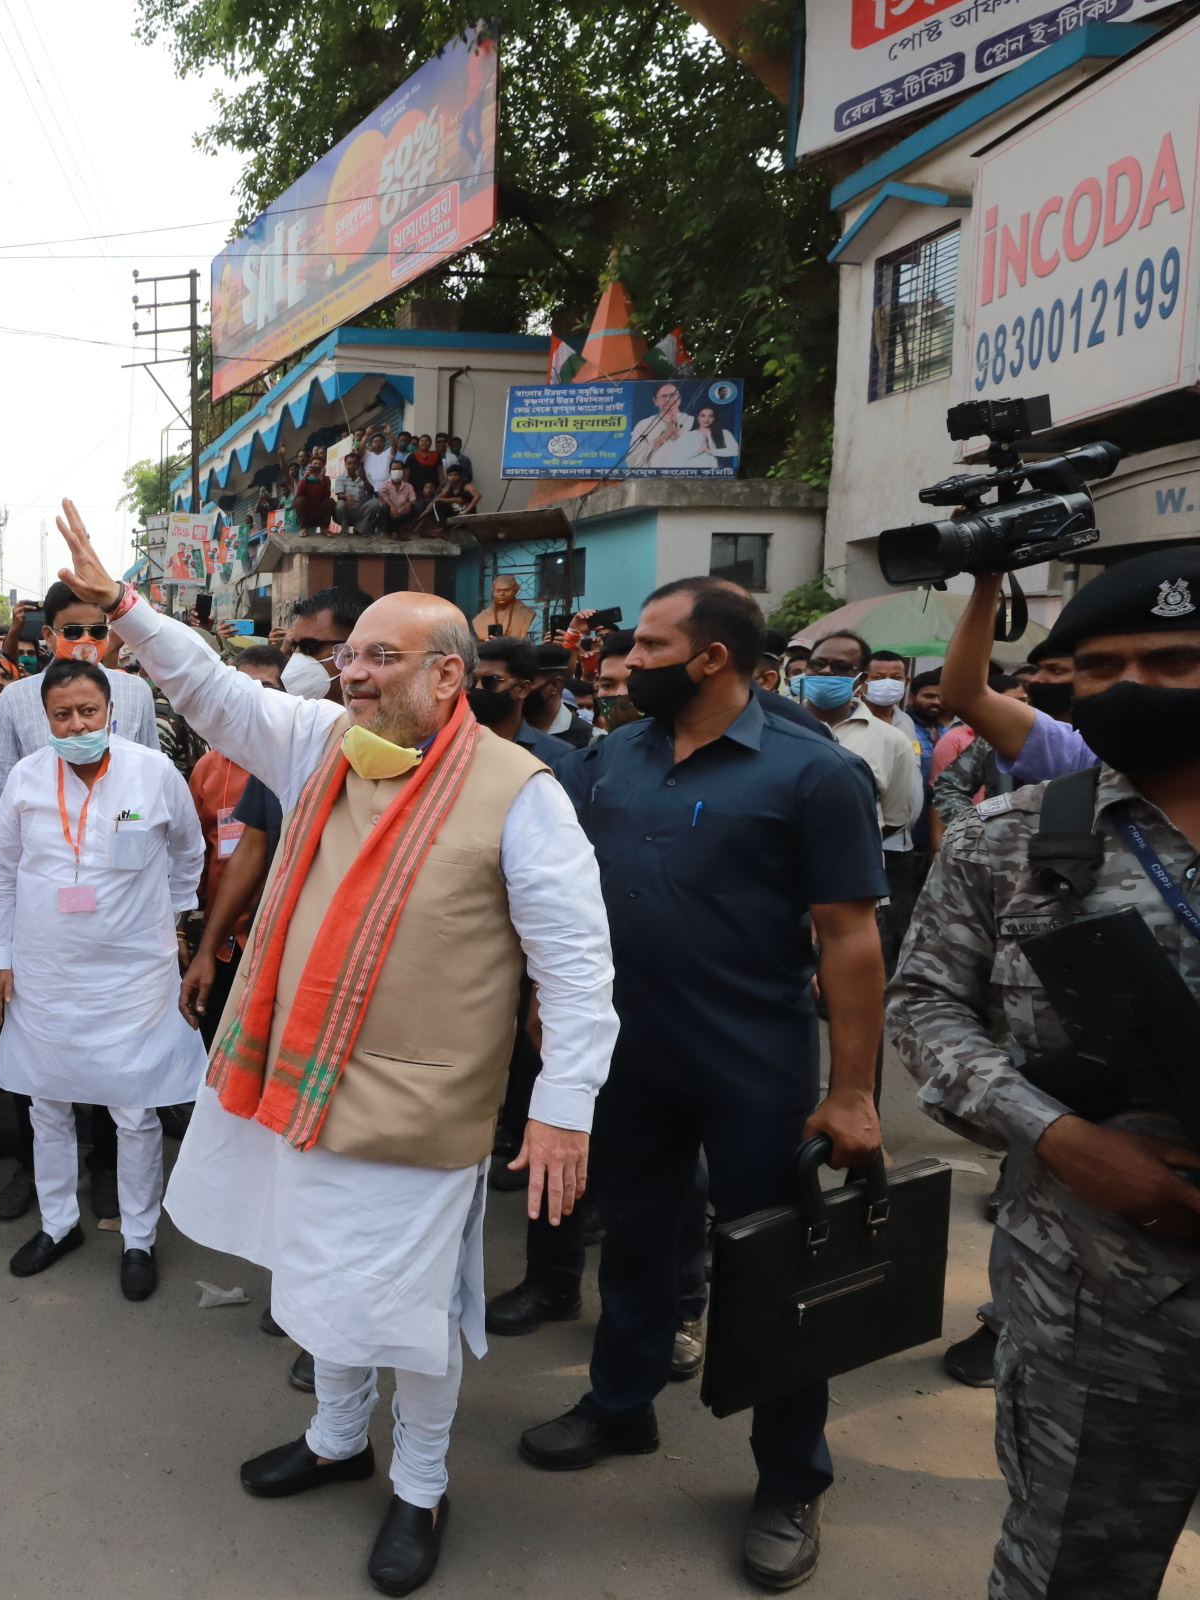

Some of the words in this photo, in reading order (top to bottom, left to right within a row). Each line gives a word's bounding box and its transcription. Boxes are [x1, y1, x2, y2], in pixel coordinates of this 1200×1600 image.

[983, 34, 1026, 67] প্লেন
[842, 101, 876, 126] রেল
[880, 61, 956, 109] ই-টিকিট
[378, 104, 439, 195] 50%
[380, 144, 439, 226] OFF
[242, 214, 307, 331] SALE
[975, 246, 1180, 391] 9830012199
[516, 417, 569, 429] কৌশানী
[660, 468, 698, 476] কংগ্রেস
[700, 467, 734, 476] কমিটি
[1128, 825, 1148, 850] CRPF
[1151, 863, 1173, 890] CRPF
